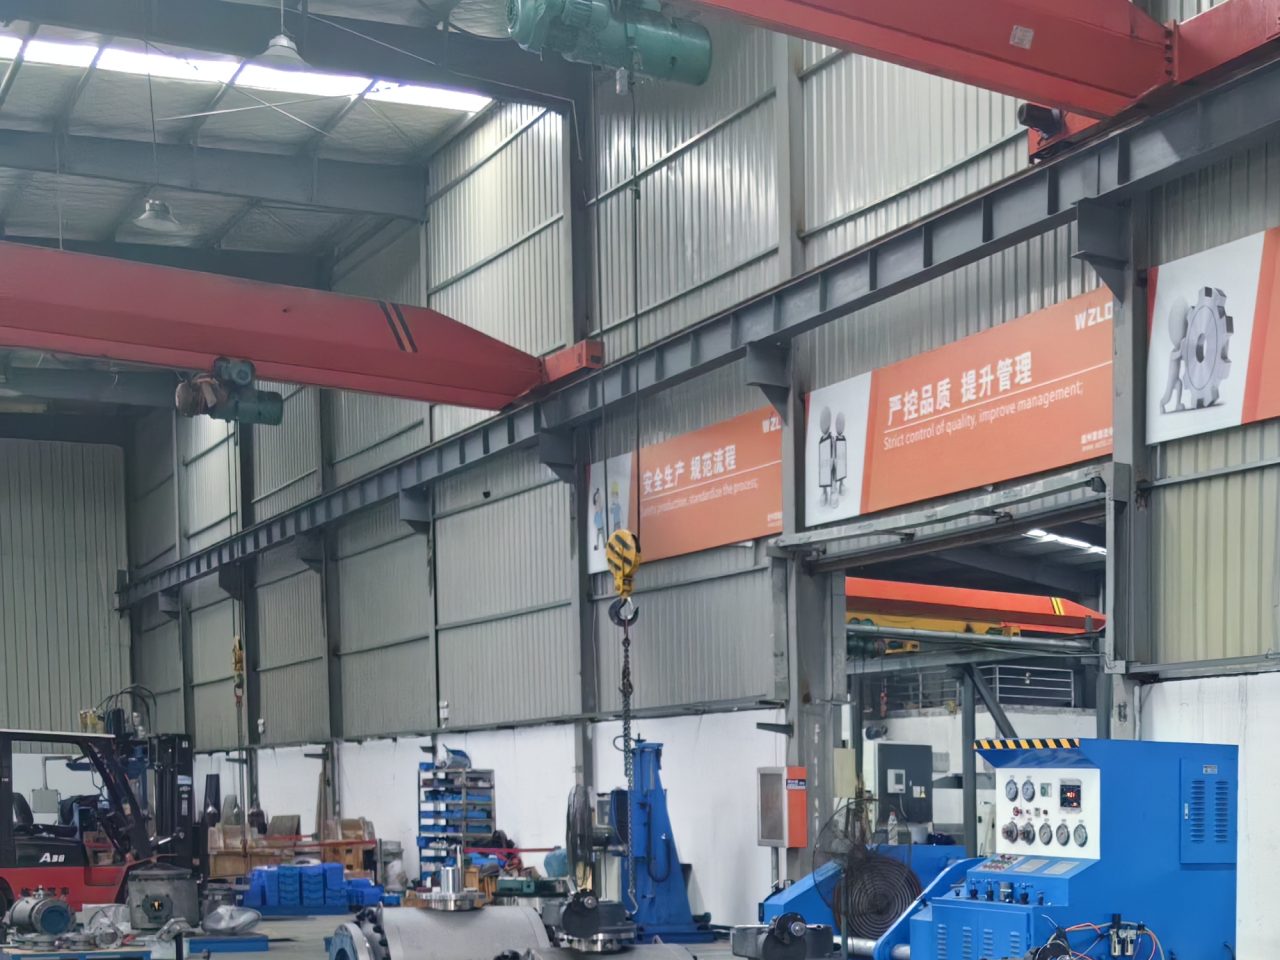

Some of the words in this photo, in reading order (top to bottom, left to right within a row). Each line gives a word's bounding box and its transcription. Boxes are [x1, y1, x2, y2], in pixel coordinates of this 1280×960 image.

[883, 432, 905, 451] Strict
[905, 422, 935, 445] control
[936, 419, 945, 436] of
[946, 412, 978, 437] quality,
[979, 402, 1017, 424] improve
[1017, 381, 1084, 409] management;
[887, 377, 952, 427] 严控品质
[960, 351, 1033, 404] 提升管理
[642, 459, 685, 496] 安全生产
